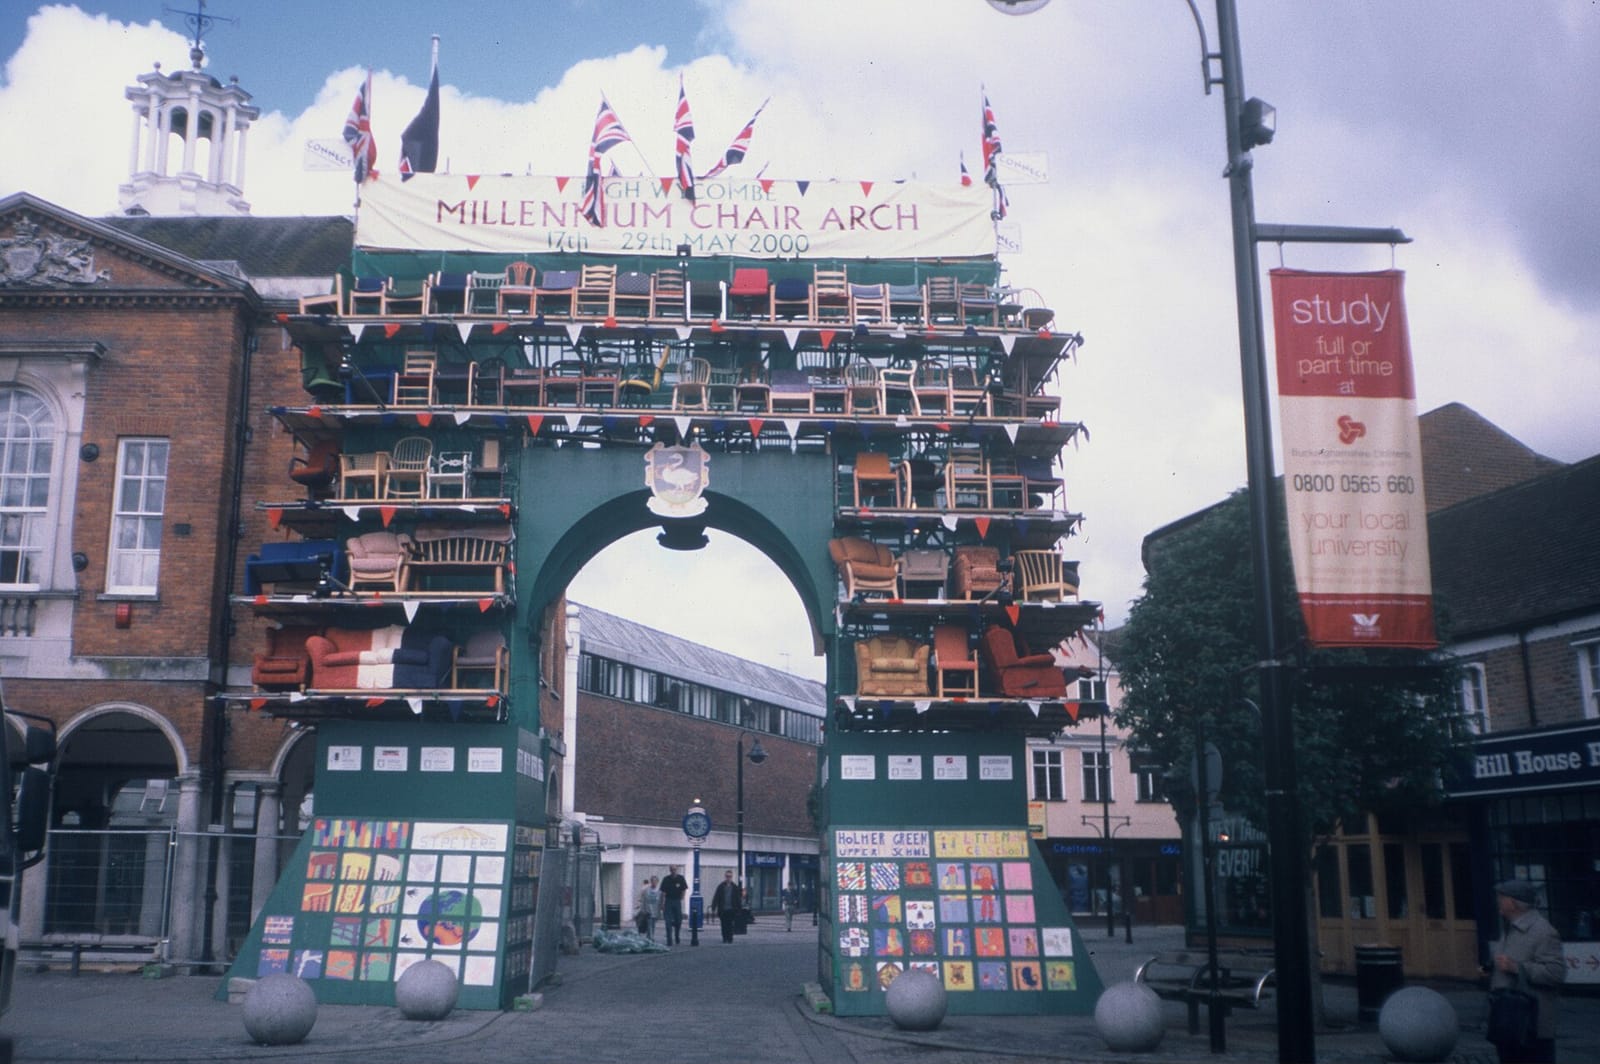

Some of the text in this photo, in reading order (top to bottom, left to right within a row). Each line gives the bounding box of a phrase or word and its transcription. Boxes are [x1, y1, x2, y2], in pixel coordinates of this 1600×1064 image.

[690, 203, 802, 230] CHAIR
[820, 203, 919, 231] ARCH
[548, 231, 588, 250] 17th
[622, 232, 672, 251] 29th
[684, 233, 738, 251] MAY
[750, 234, 809, 253] 2000
[1292, 293, 1391, 332] study
[1316, 336, 1372, 356] full or
[1297, 357, 1393, 377] part time
[1339, 378, 1356, 395] at
[1293, 474, 1415, 494] 0800 0565 660
[1302, 508, 1410, 533] your local
[1311, 537, 1409, 561] university
[1474, 753, 1512, 779] Hill
[1514, 751, 1581, 774] House
[892, 832, 928, 846] GREEN
